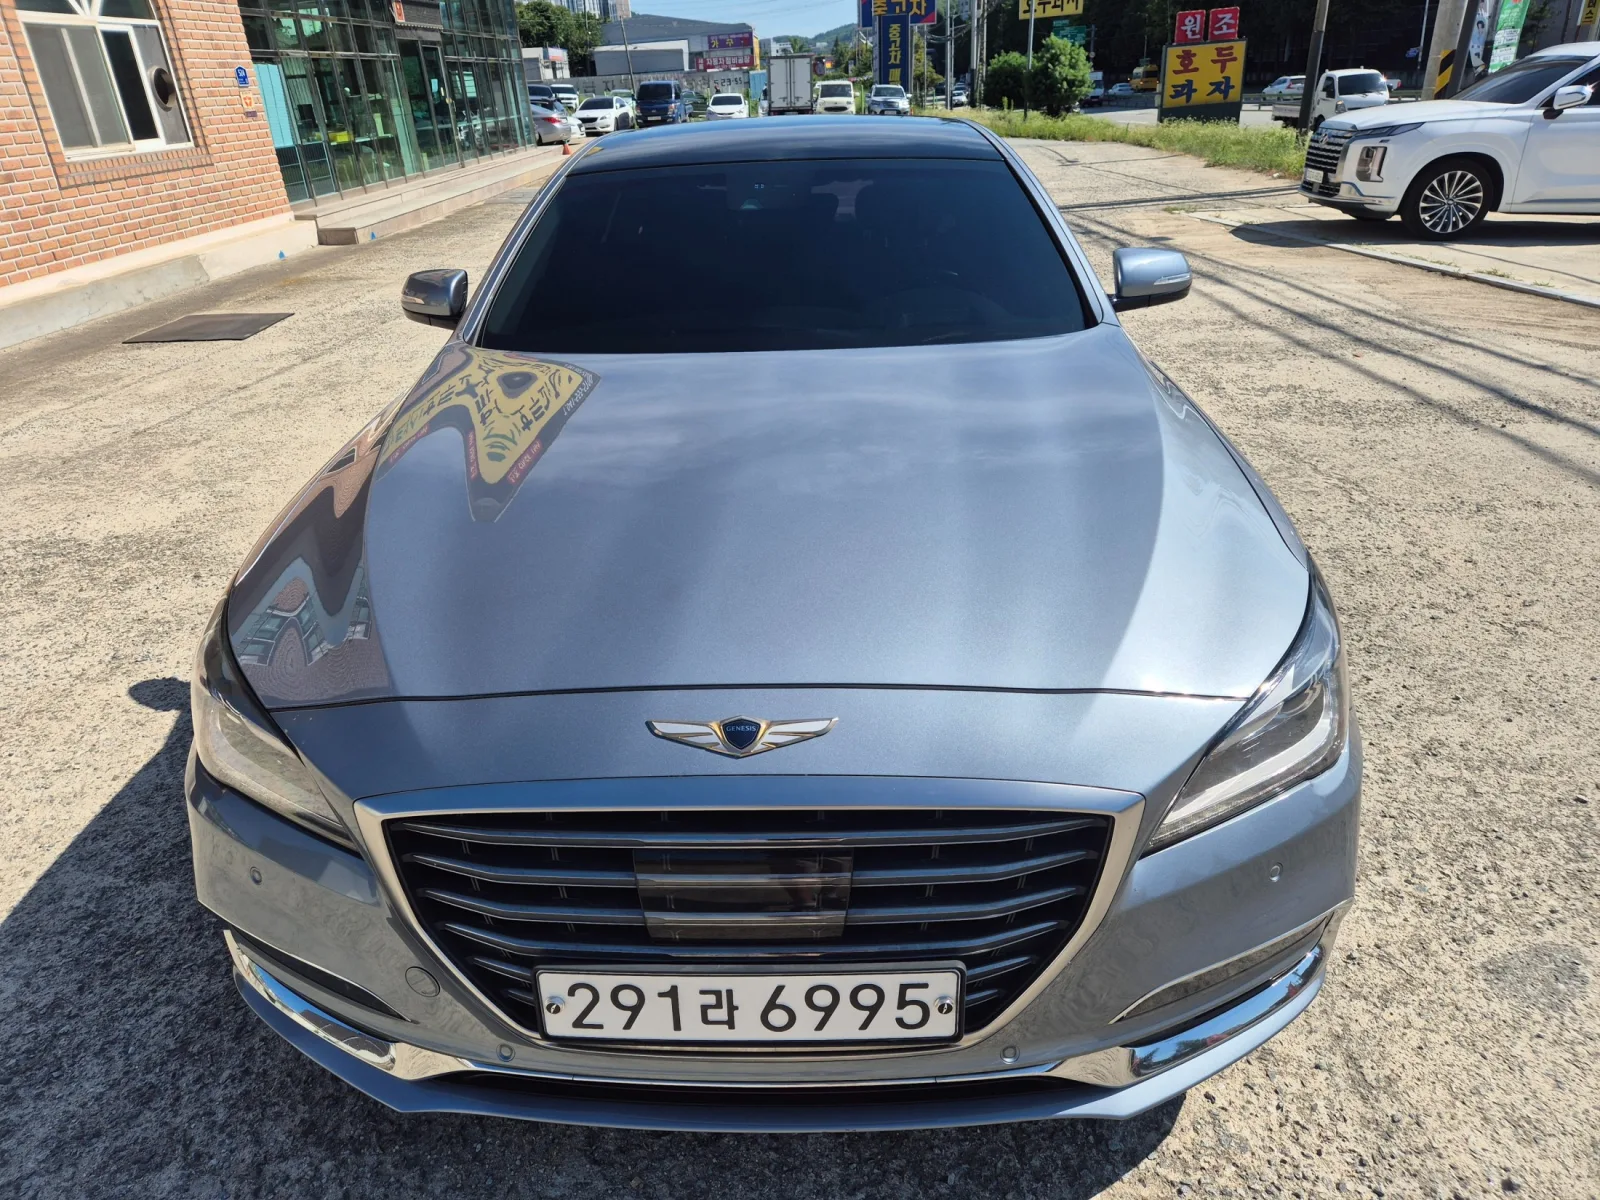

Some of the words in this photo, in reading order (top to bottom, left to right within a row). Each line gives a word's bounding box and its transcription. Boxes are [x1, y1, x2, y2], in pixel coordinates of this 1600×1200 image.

[1181, 14, 1236, 39] 원조
[888, 24, 901, 64] 중고차
[1172, 46, 1238, 75] 호두
[1169, 76, 1235, 103] 과자
[566, 982, 739, 1032] 291라
[760, 983, 931, 1033] 6995
